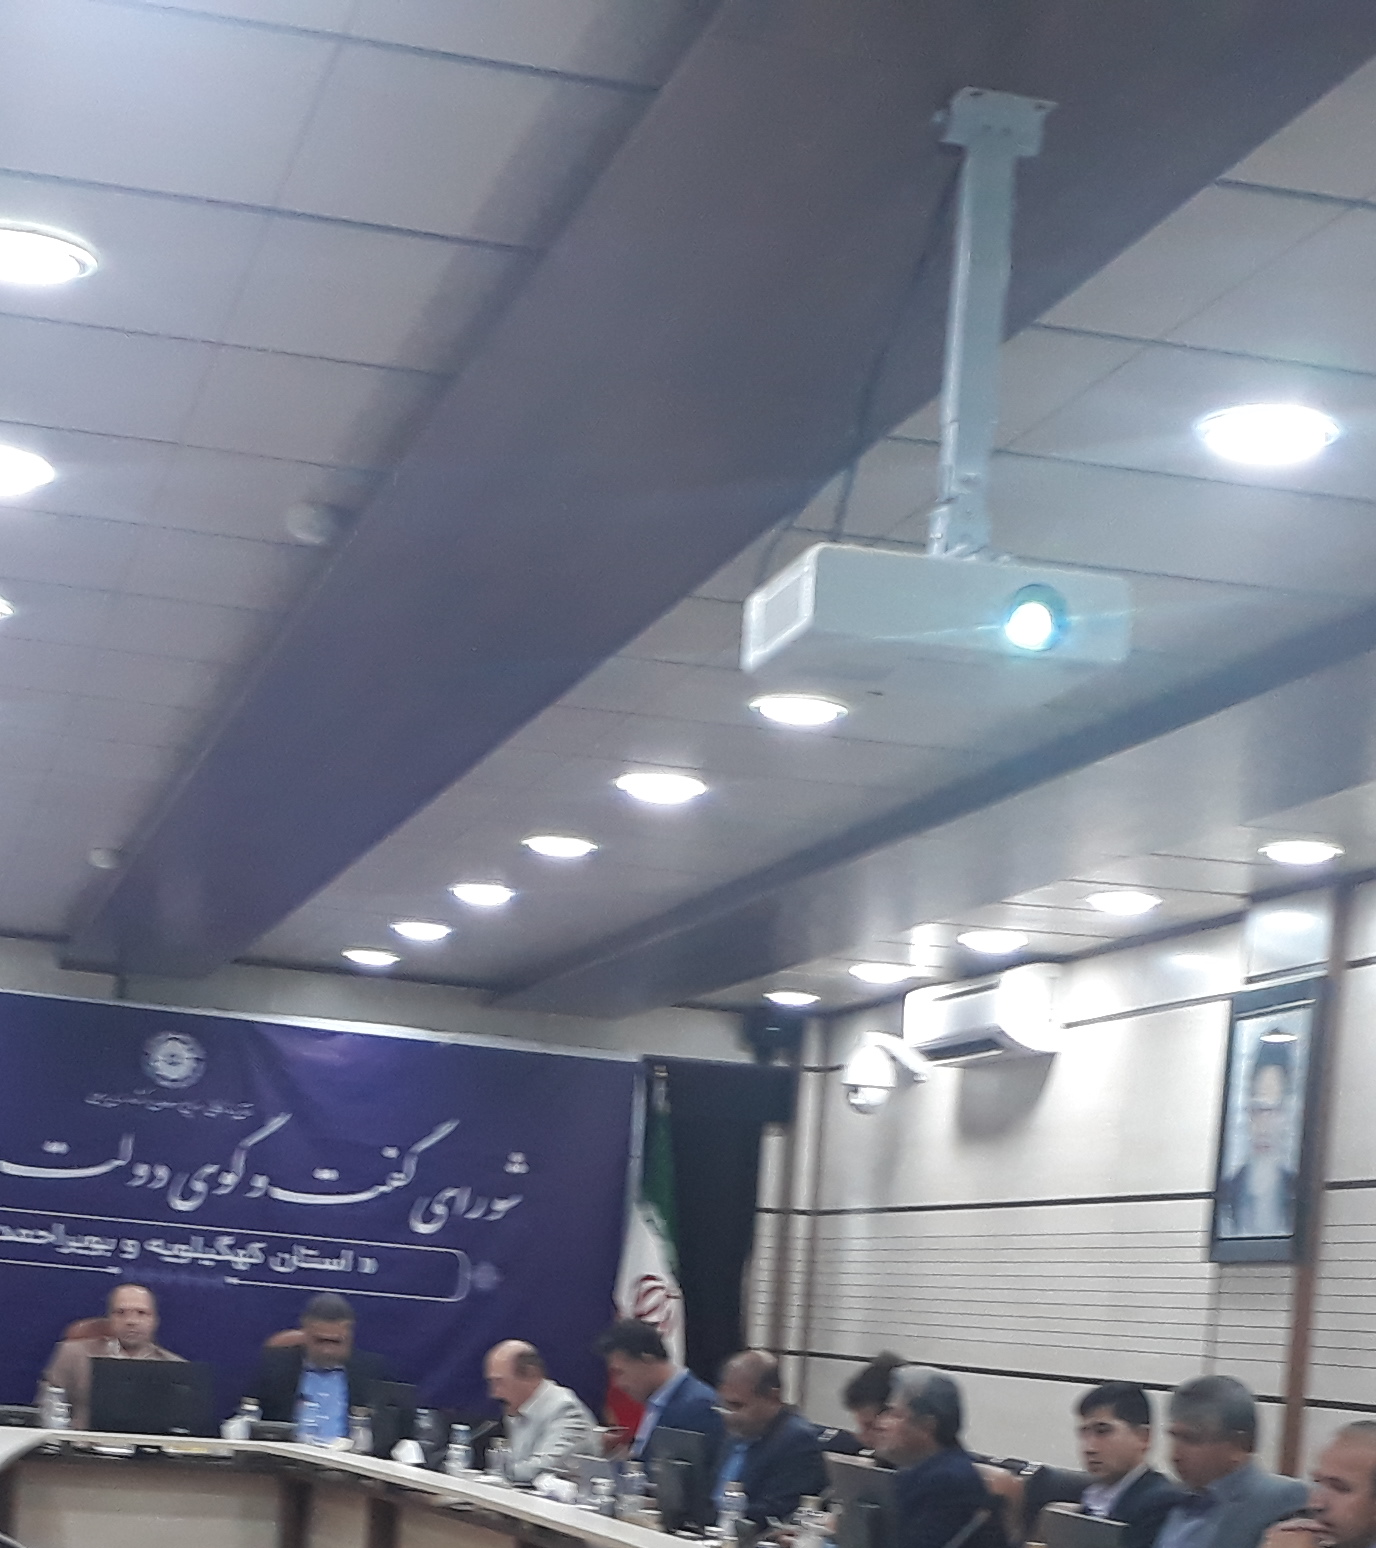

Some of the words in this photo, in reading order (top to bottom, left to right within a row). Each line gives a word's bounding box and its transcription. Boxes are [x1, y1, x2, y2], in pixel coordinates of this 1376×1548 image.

[166, 1111, 293, 1212] گوی
[242, 1172, 271, 1198] و
[266, 1118, 460, 1205] گفت
[408, 1150, 530, 1234] شورای
